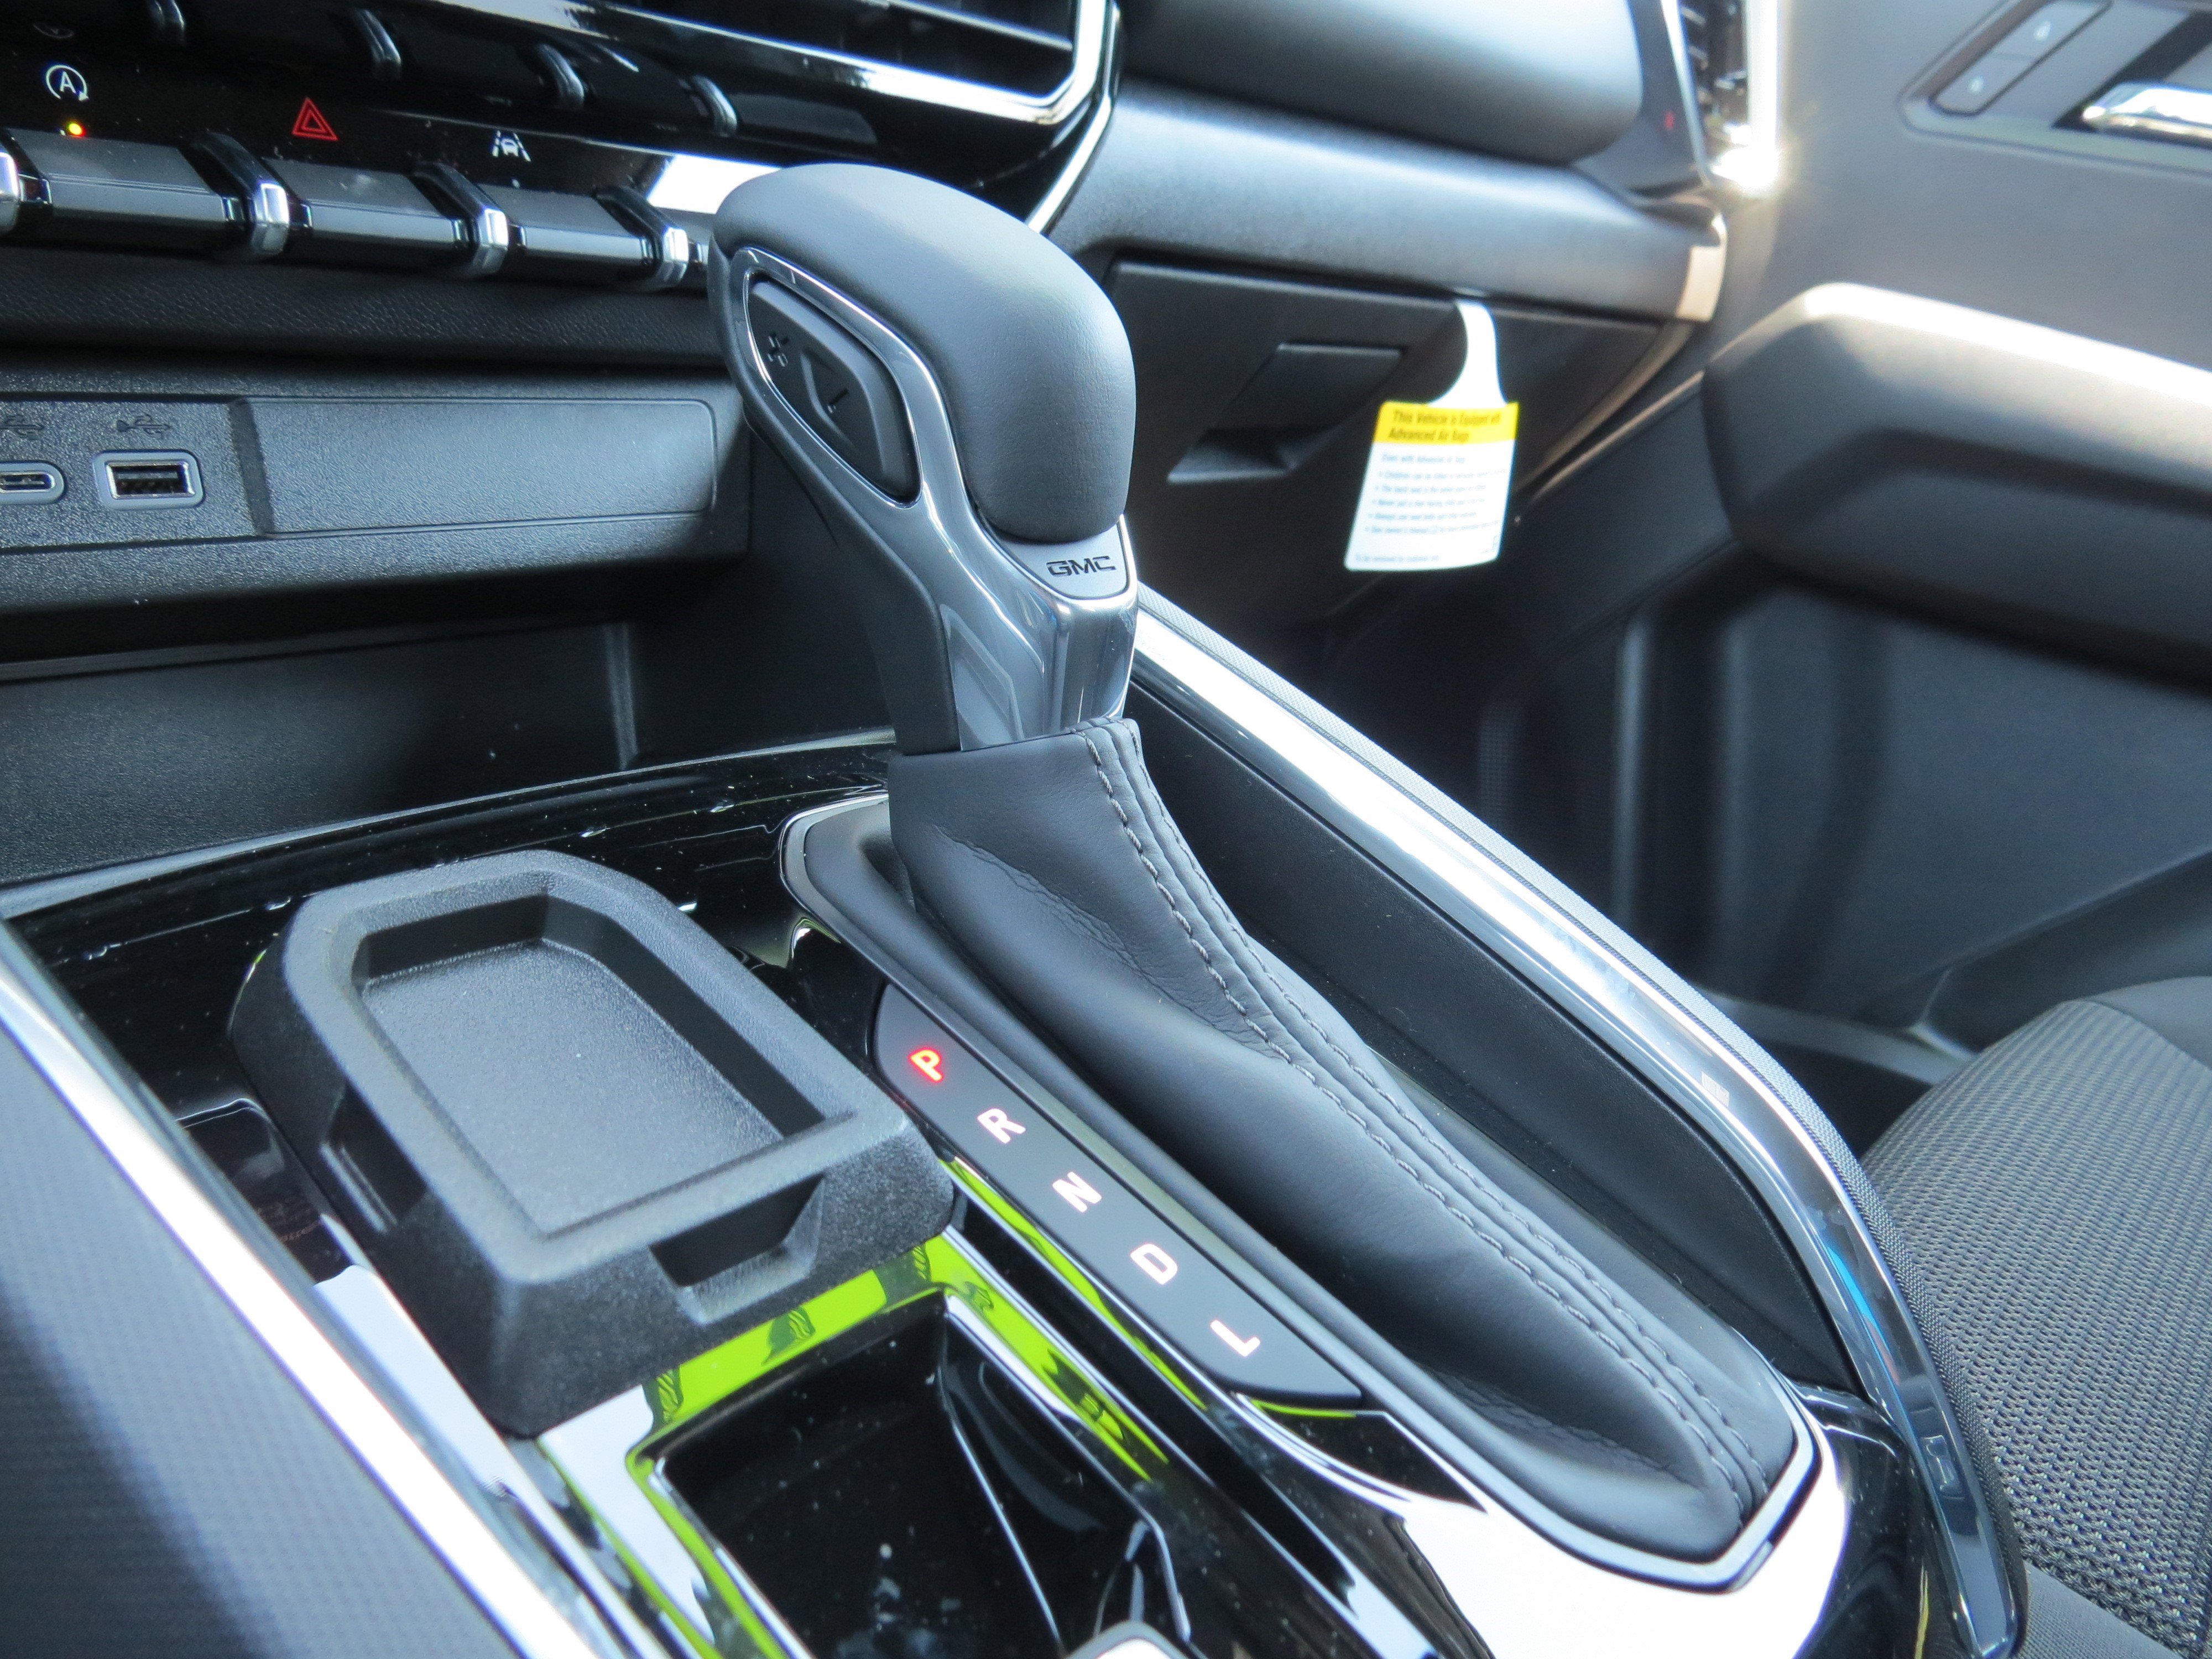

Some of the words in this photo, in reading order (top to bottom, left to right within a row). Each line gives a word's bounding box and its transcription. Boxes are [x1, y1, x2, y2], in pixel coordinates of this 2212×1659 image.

[60, 70, 77, 94] A
[1046, 555, 1116, 577] GMC
[909, 1049, 943, 1082] P
[977, 1108, 1026, 1144] R
[1052, 1171, 1102, 1213] N
[1130, 1243, 1178, 1285] D
[1209, 1319, 1261, 1357] L
